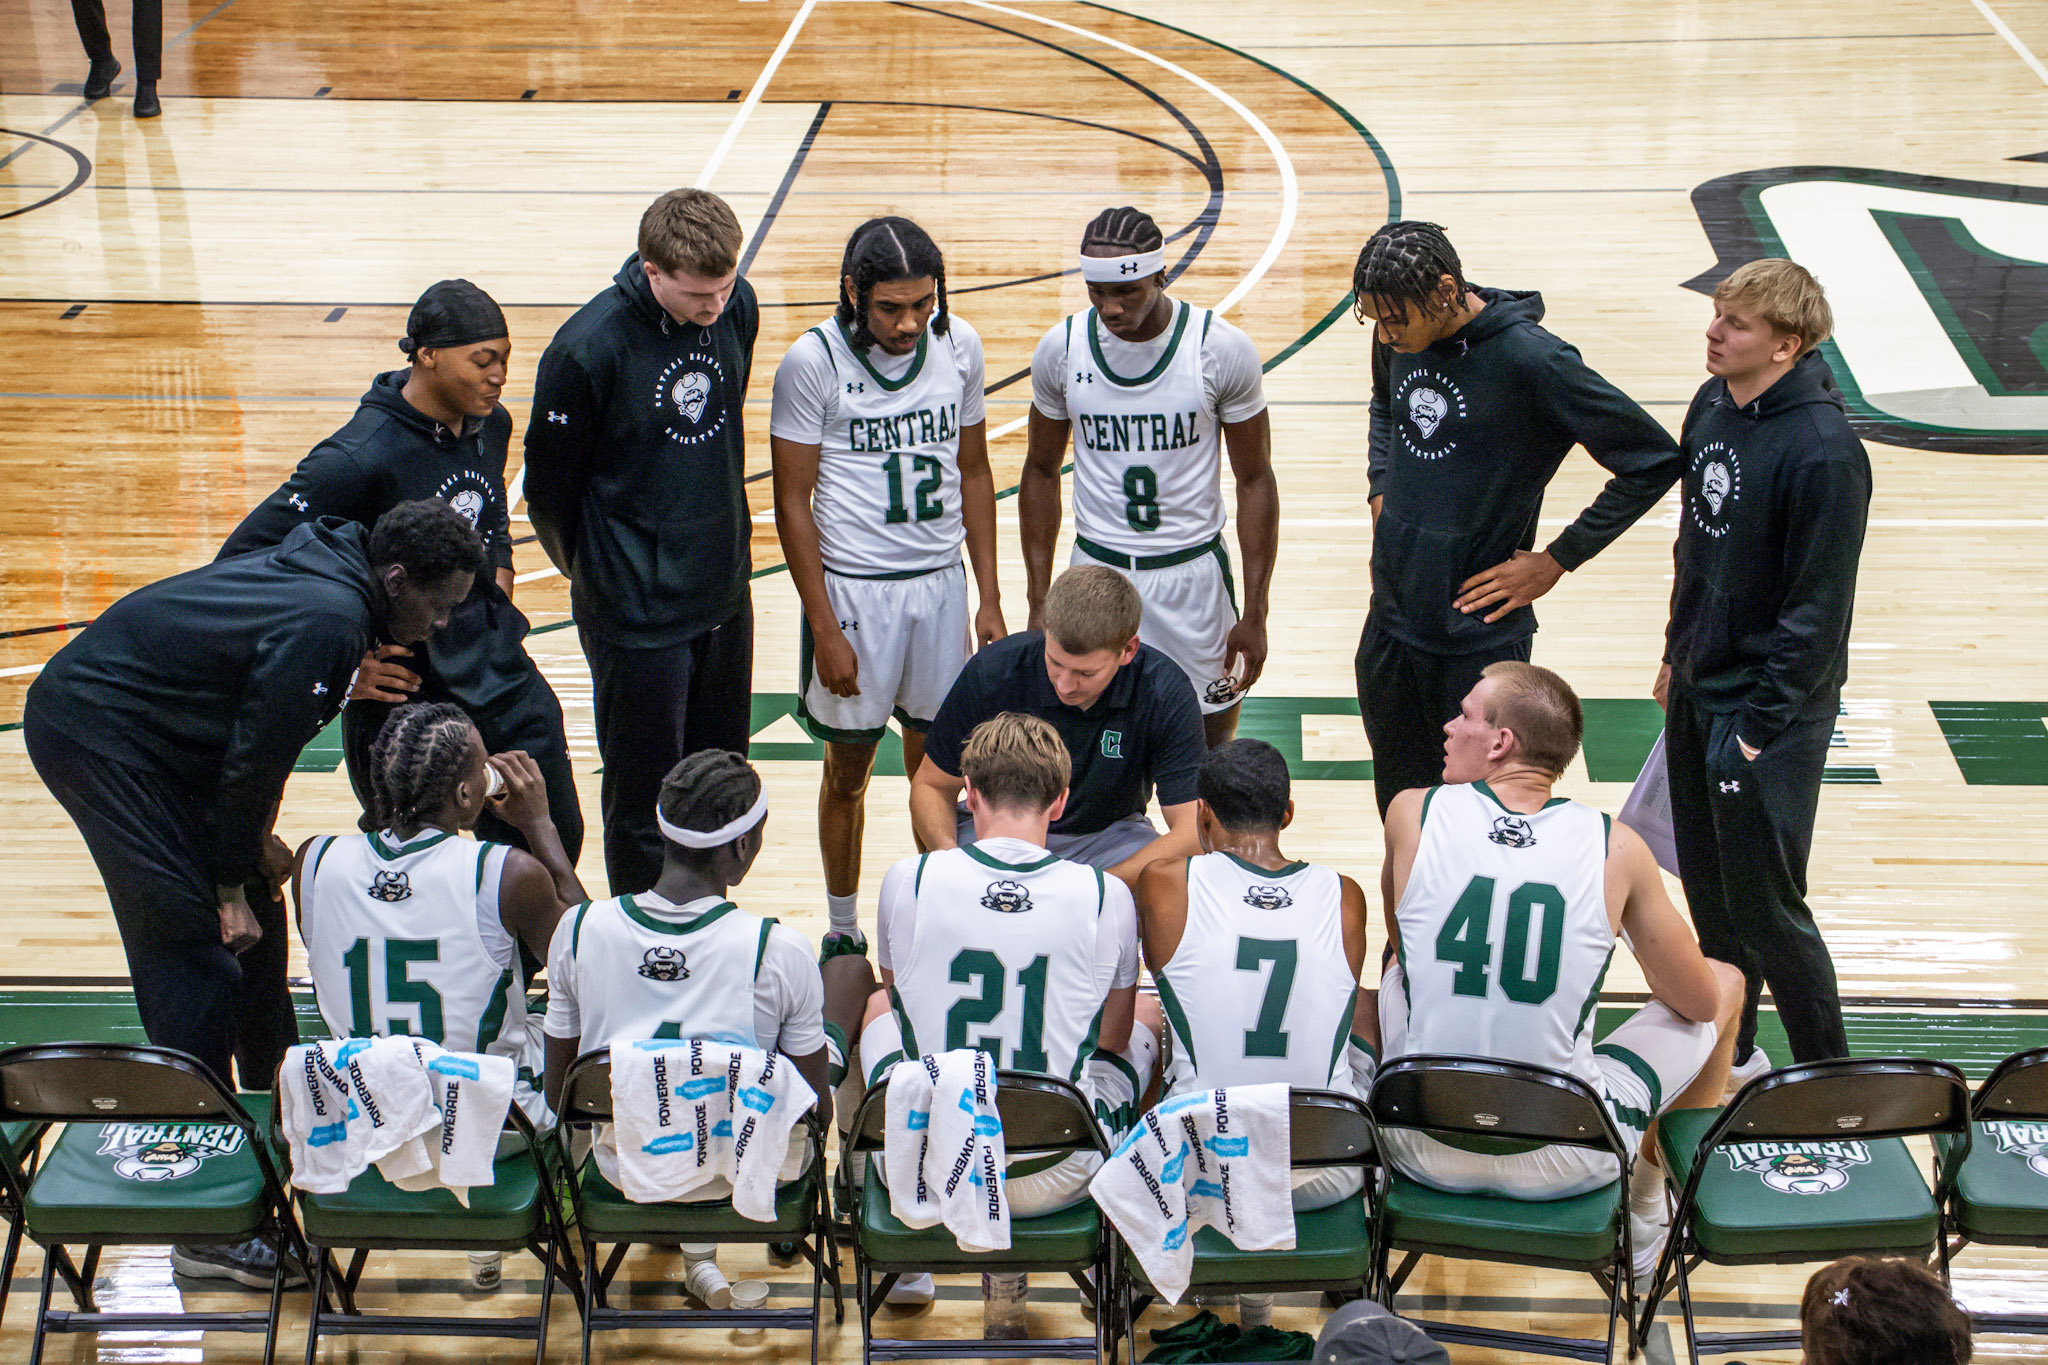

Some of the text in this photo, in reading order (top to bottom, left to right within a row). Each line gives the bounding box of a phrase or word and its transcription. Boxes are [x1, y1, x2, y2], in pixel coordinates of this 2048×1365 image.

[849, 403, 957, 452] CENTRAL
[1435, 372, 1467, 418] RAIDERS
[1080, 411, 1200, 452] CENTRAL
[882, 452, 944, 524] 12
[1122, 464, 1162, 532] 8
[1435, 872, 1567, 1007] 40
[342, 936, 447, 1047] 15
[944, 946, 1050, 1074] 21
[1233, 934, 1299, 1060] 7
[305, 1049, 327, 1116] POWERADE
[348, 1058, 384, 1129] POWERADE
[441, 1081, 460, 1155] POWERADE
[654, 1054, 671, 1127] POWERADE
[97, 1122, 246, 1154] CENTRAL
[695, 1100, 708, 1168] POWERADE
[1180, 1111, 1208, 1174] POWERADE
[983, 1145, 1000, 1221] POWERADE
[1129, 1149, 1173, 1220] POWERADE
